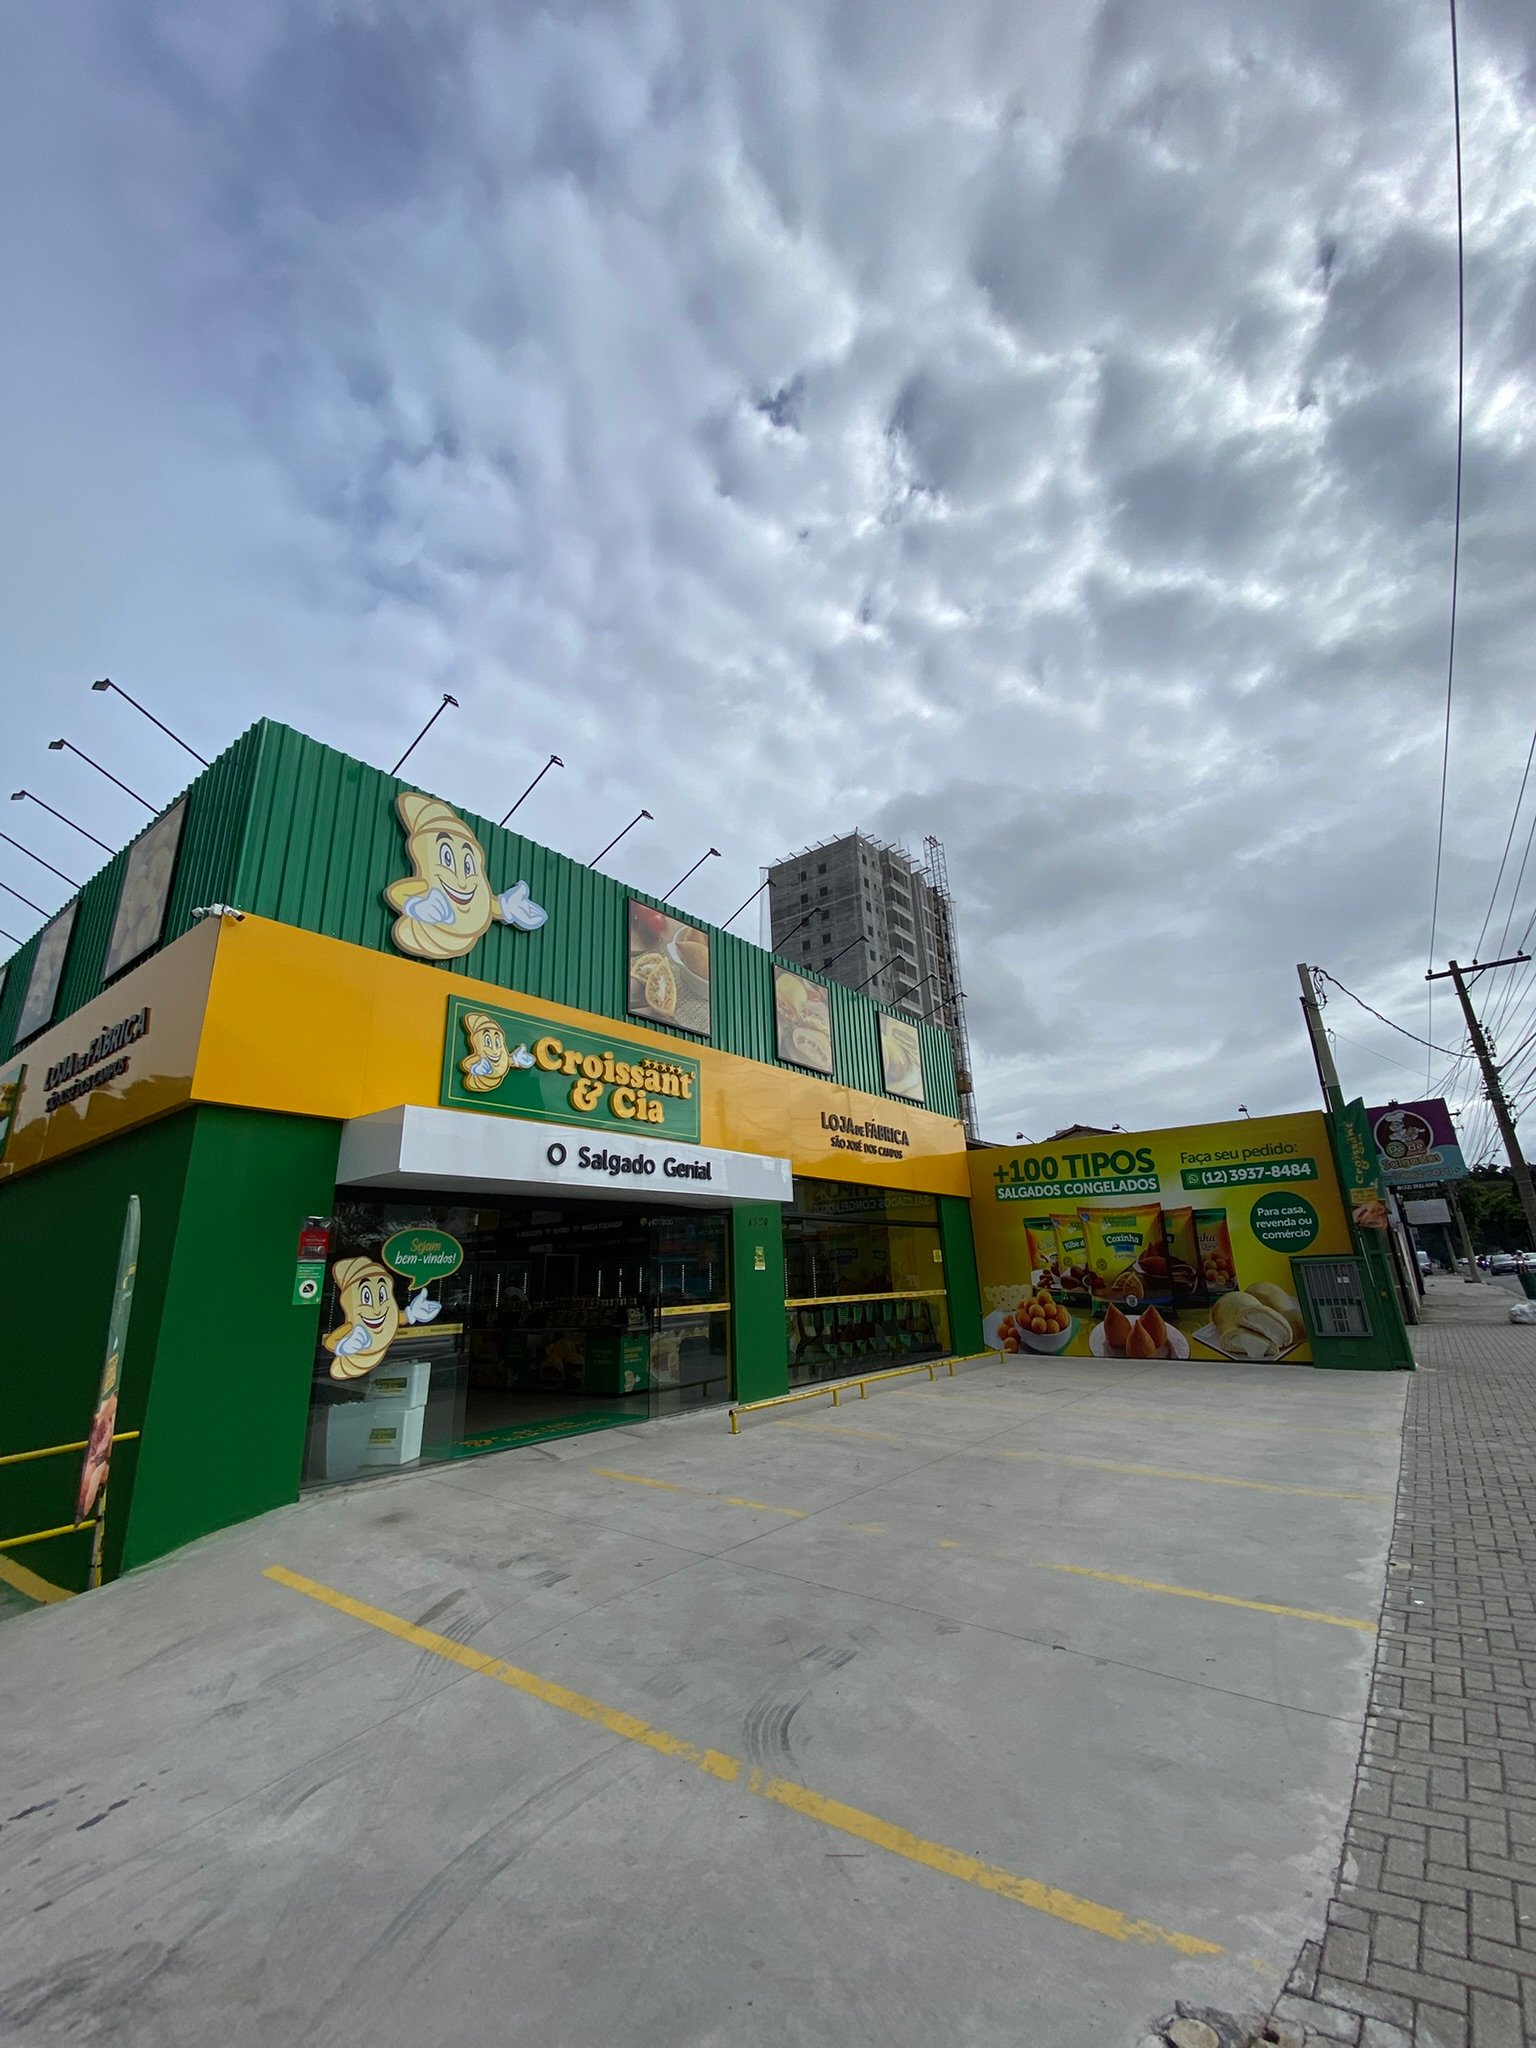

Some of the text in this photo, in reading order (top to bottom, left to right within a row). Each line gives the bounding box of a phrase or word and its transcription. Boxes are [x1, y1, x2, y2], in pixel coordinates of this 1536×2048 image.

[43, 1053, 78, 1091] LOJA
[533, 1037, 693, 1100] Croissant
[571, 1077, 664, 1124] & Cia
[821, 1112, 909, 1146] LOJA DE FÁBRICA
[831, 1135, 903, 1159] SÃO JOSÉ DOS CAMPOS
[1180, 1143, 1298, 1165] Faça seu pedido:
[1408, 1143, 1424, 1152] de
[547, 1143, 712, 1181] O Salgado Genial
[993, 1148, 1155, 1183] +100 TIPOS
[1381, 1154, 1442, 1170] Salgados
[1201, 1163, 1311, 1185] (12) 3937-8484
[997, 1178, 1157, 1199] SALGADOS CONGELADOS
[1257, 1205, 1306, 1217] Para casa,
[1256, 1217, 1312, 1229] revenda ou
[1106, 1234, 1139, 1244] Coxinha
[1262, 1228, 1310, 1240] comércio
[410, 1238, 441, 1255] Sejam
[1064, 1240, 1080, 1250] Kibe
[395, 1250, 457, 1265] bem-vindos!
